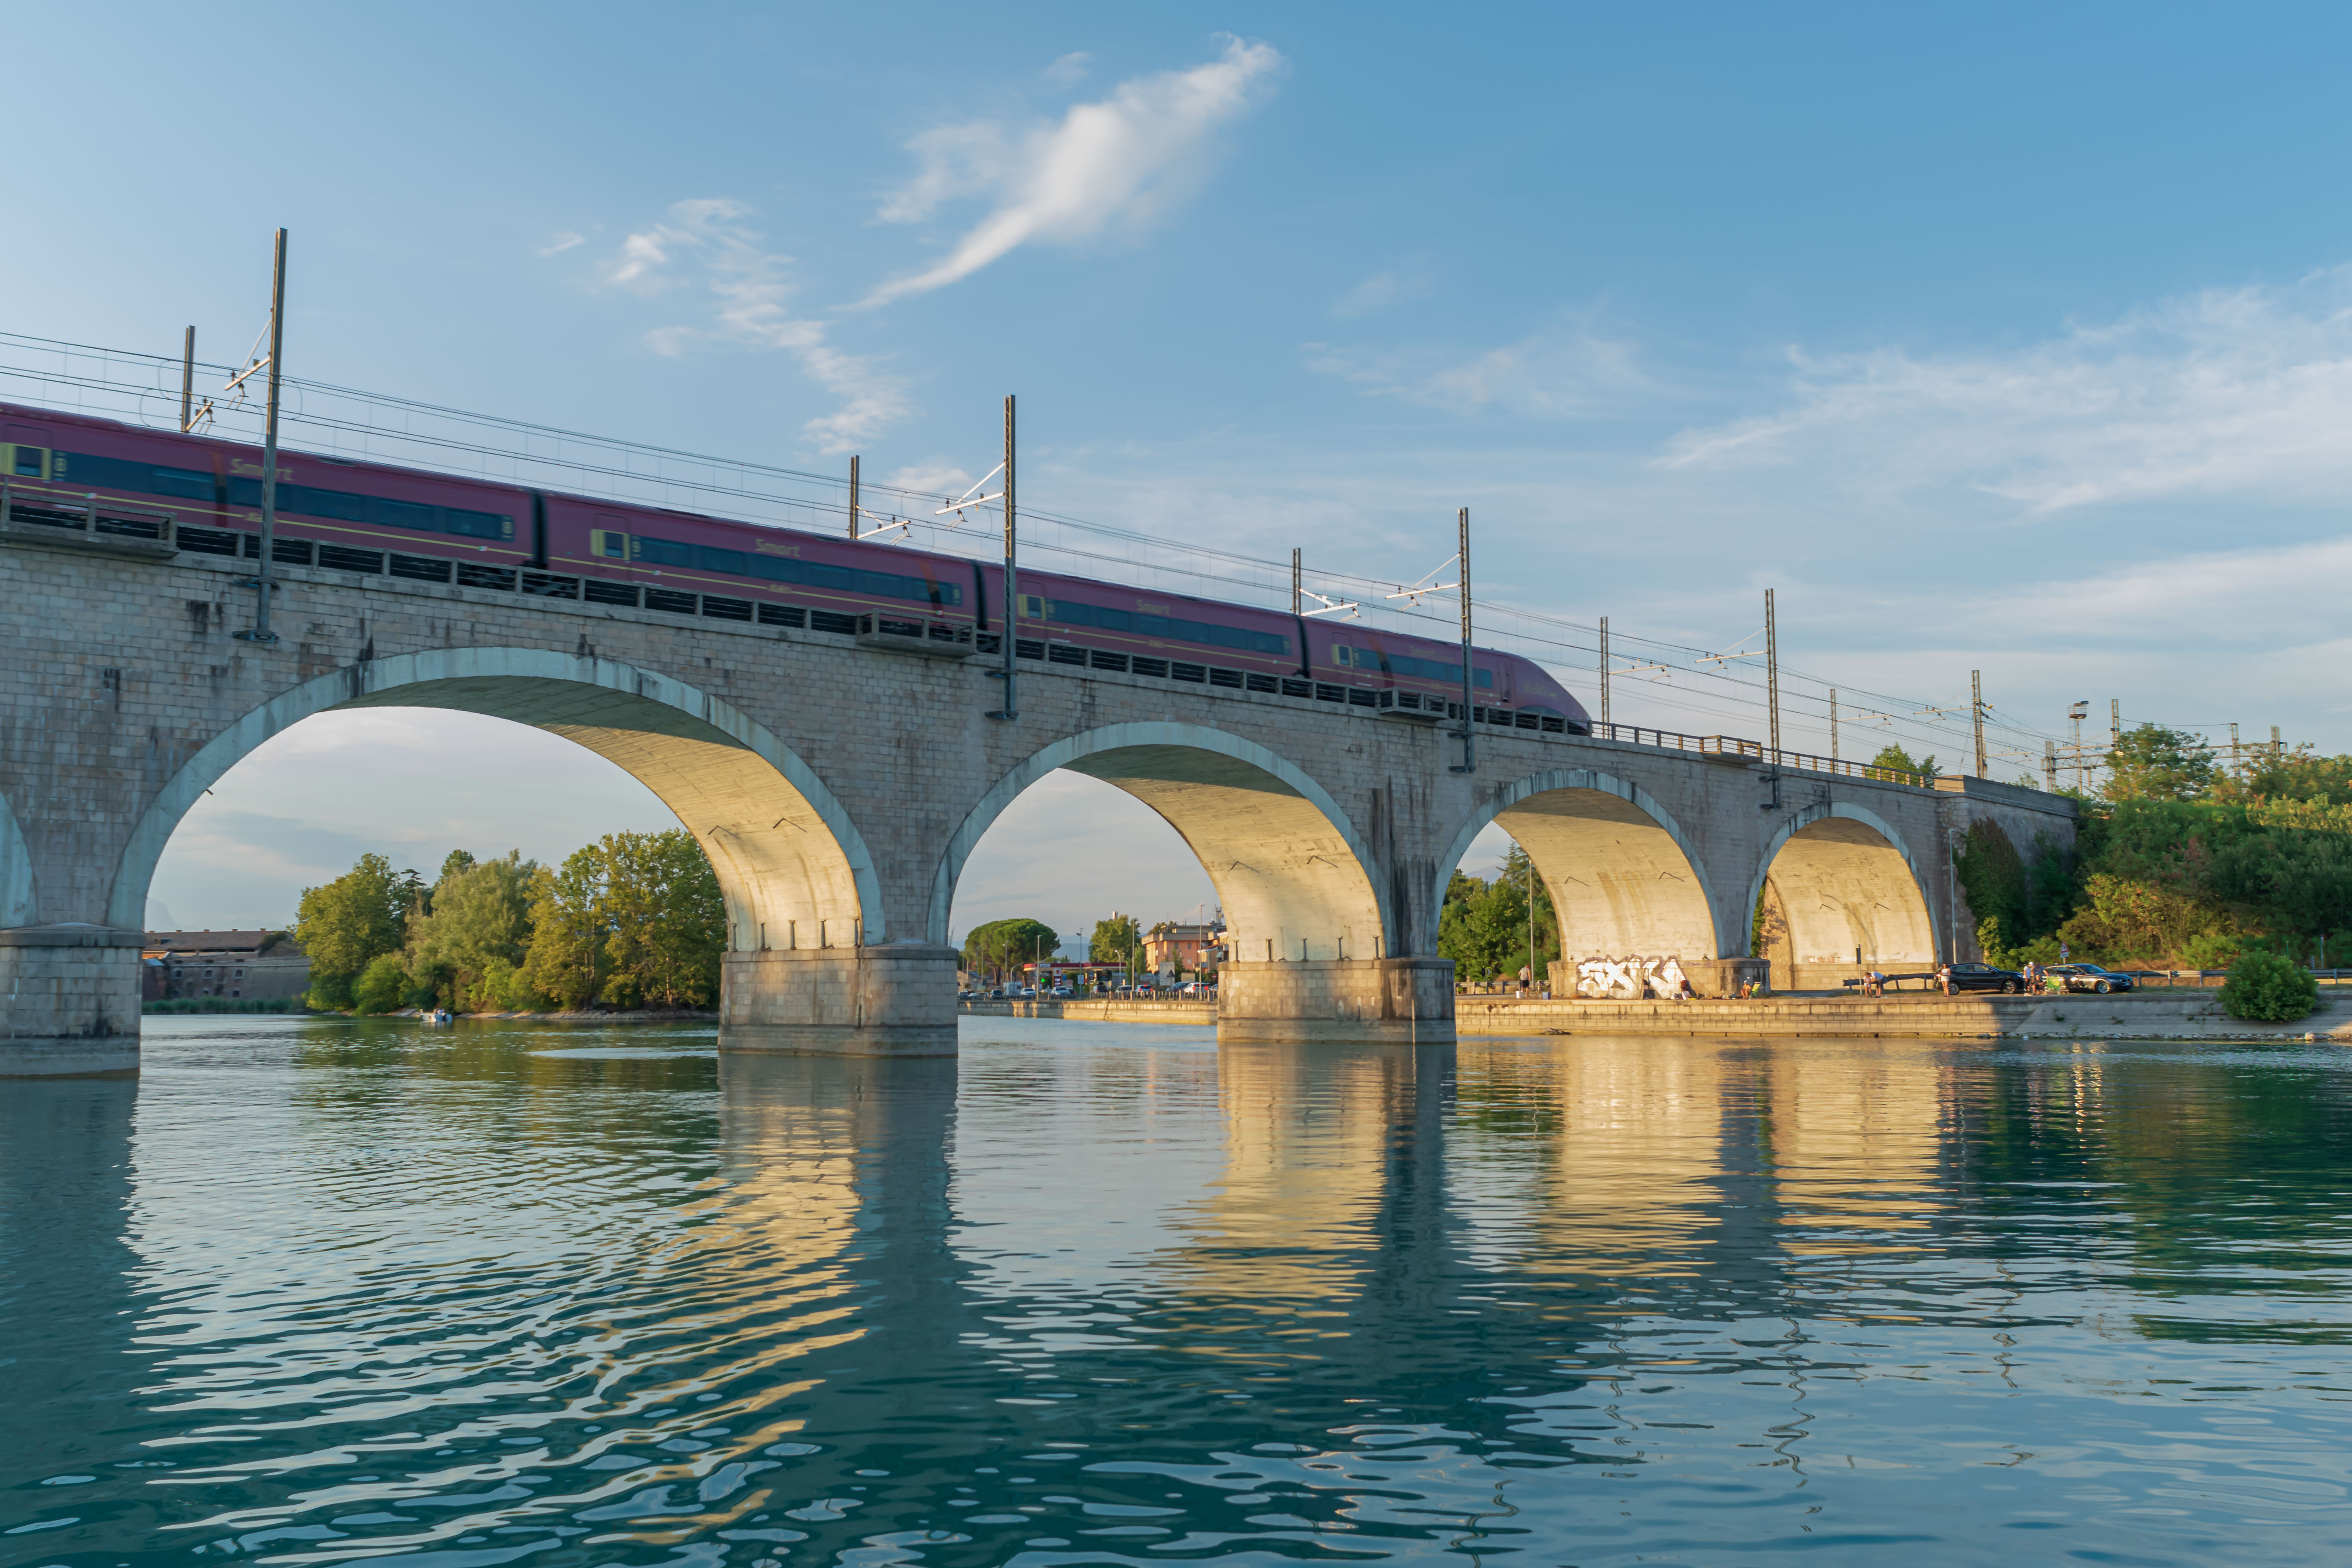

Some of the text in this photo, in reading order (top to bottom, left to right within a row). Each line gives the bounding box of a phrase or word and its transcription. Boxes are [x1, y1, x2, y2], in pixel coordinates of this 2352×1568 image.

[54, 458, 67, 471] 8
[230, 458, 294, 481] Smrt
[755, 539, 801, 557] Smart
[1136, 600, 1170, 616] Smart
